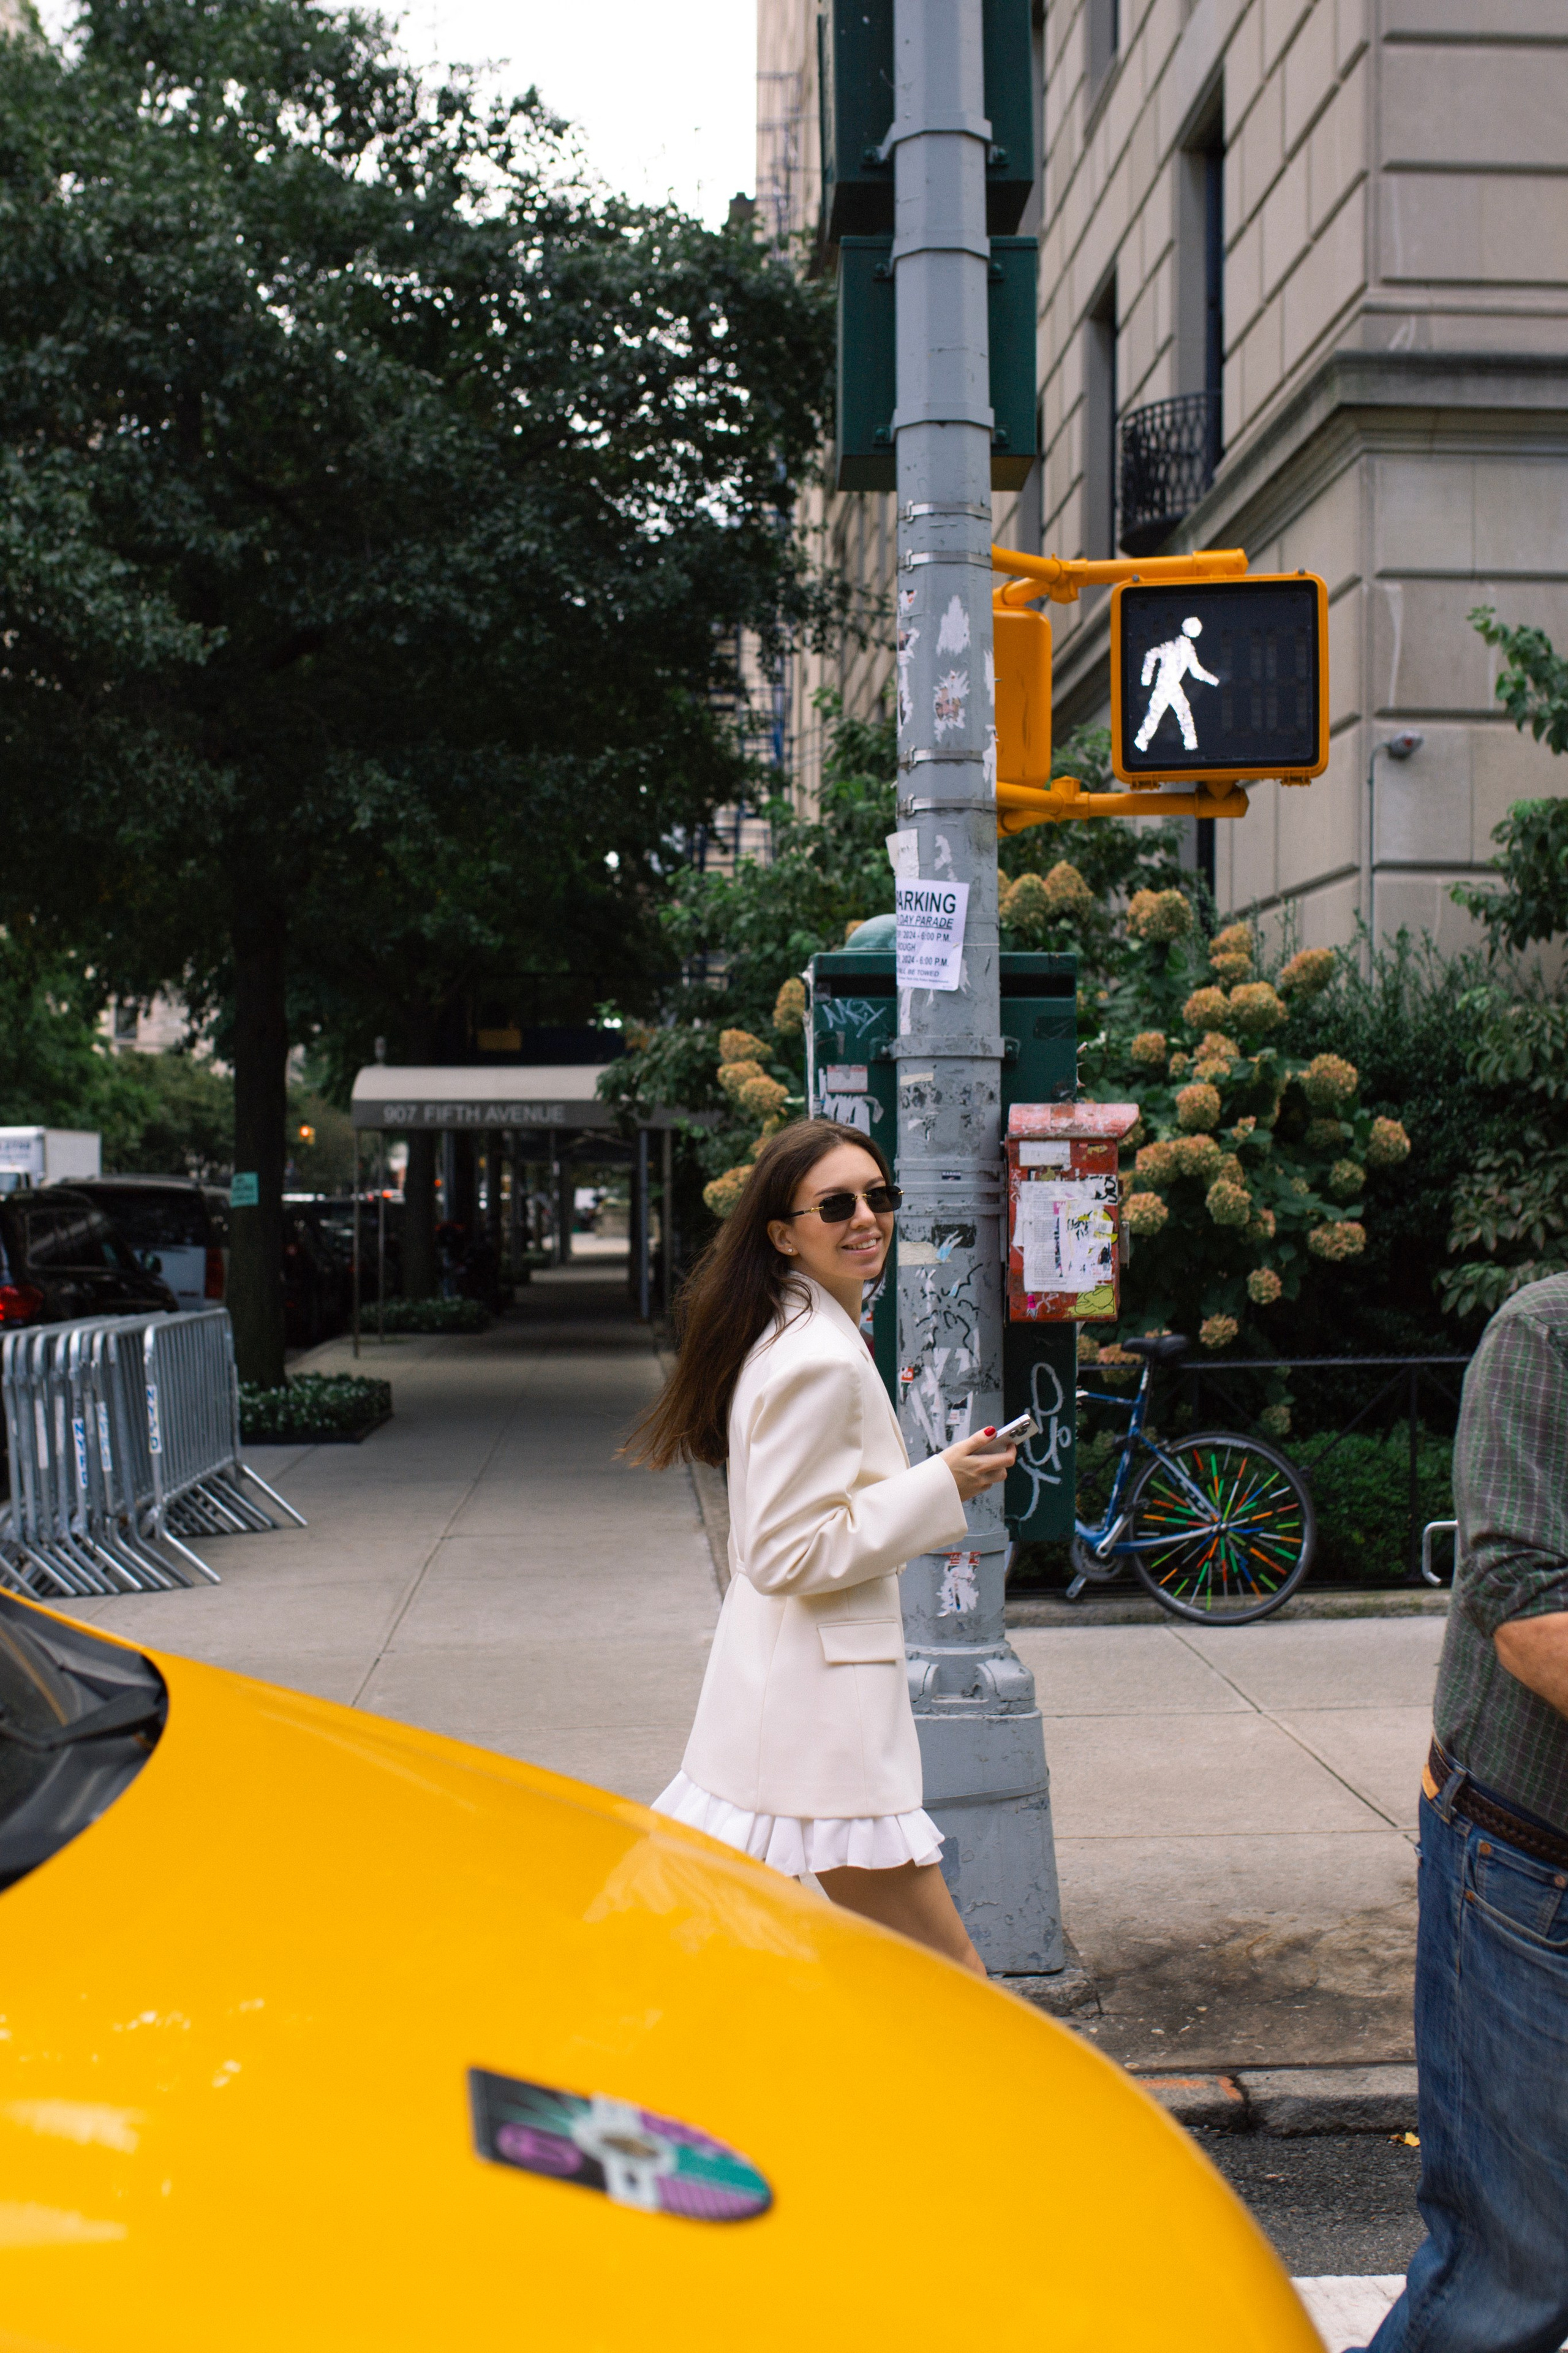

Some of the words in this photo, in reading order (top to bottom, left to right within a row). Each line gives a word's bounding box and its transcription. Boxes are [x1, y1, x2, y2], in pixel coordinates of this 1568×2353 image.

[896, 890, 956, 914] ARKING
[900, 915, 914, 924] DAY
[915, 916, 954, 929] PARADE
[903, 931, 916, 939] 2024
[936, 933, 952, 942] P.M.
[901, 955, 914, 964] 2024
[934, 957, 949, 967] P.M.
[383, 1105, 417, 1124] 907
[423, 1105, 481, 1124] FIFTH
[484, 1105, 565, 1124] AVENUE
